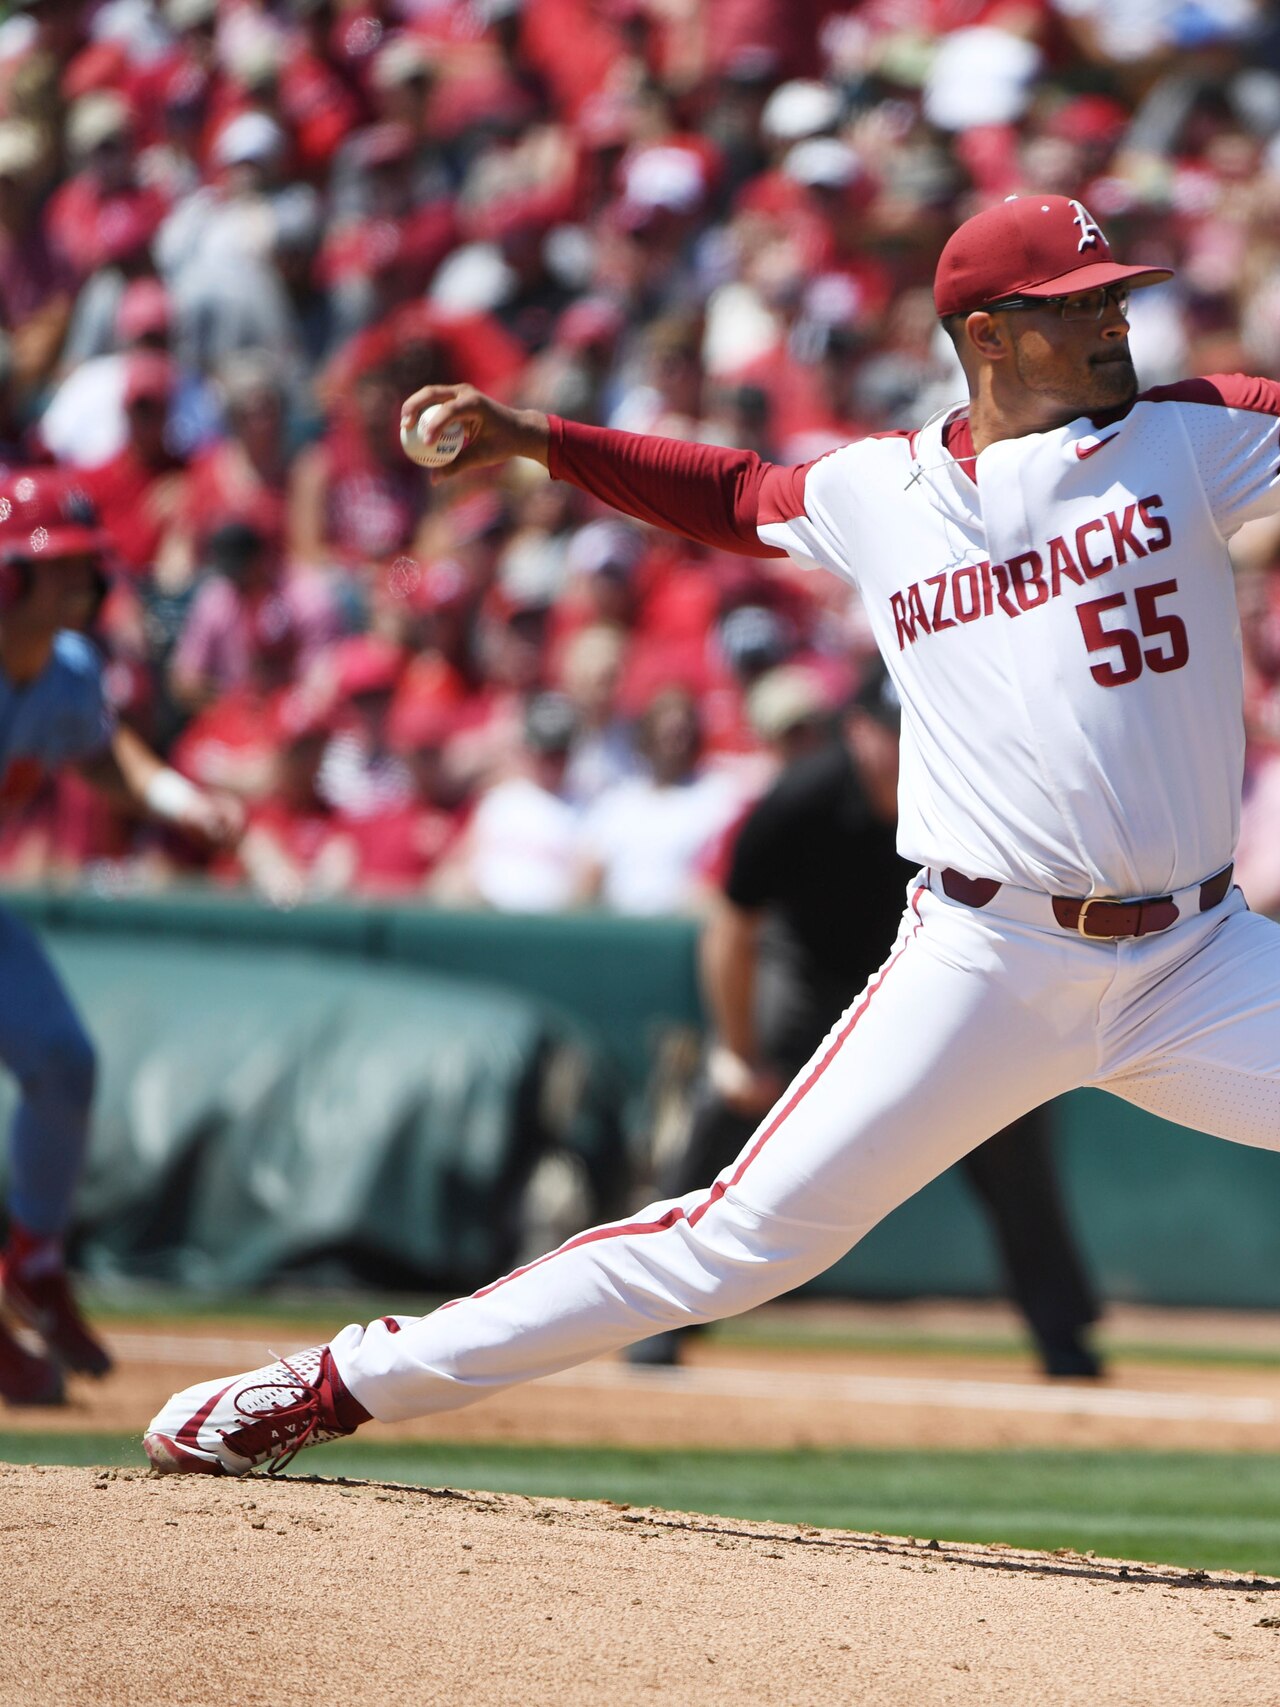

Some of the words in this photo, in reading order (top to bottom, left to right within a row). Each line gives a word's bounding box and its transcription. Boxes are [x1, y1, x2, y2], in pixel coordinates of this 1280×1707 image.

[1068, 199, 1110, 254] A
[889, 494, 1172, 652] RAZORBACKS
[1075, 578, 1189, 688] 55
